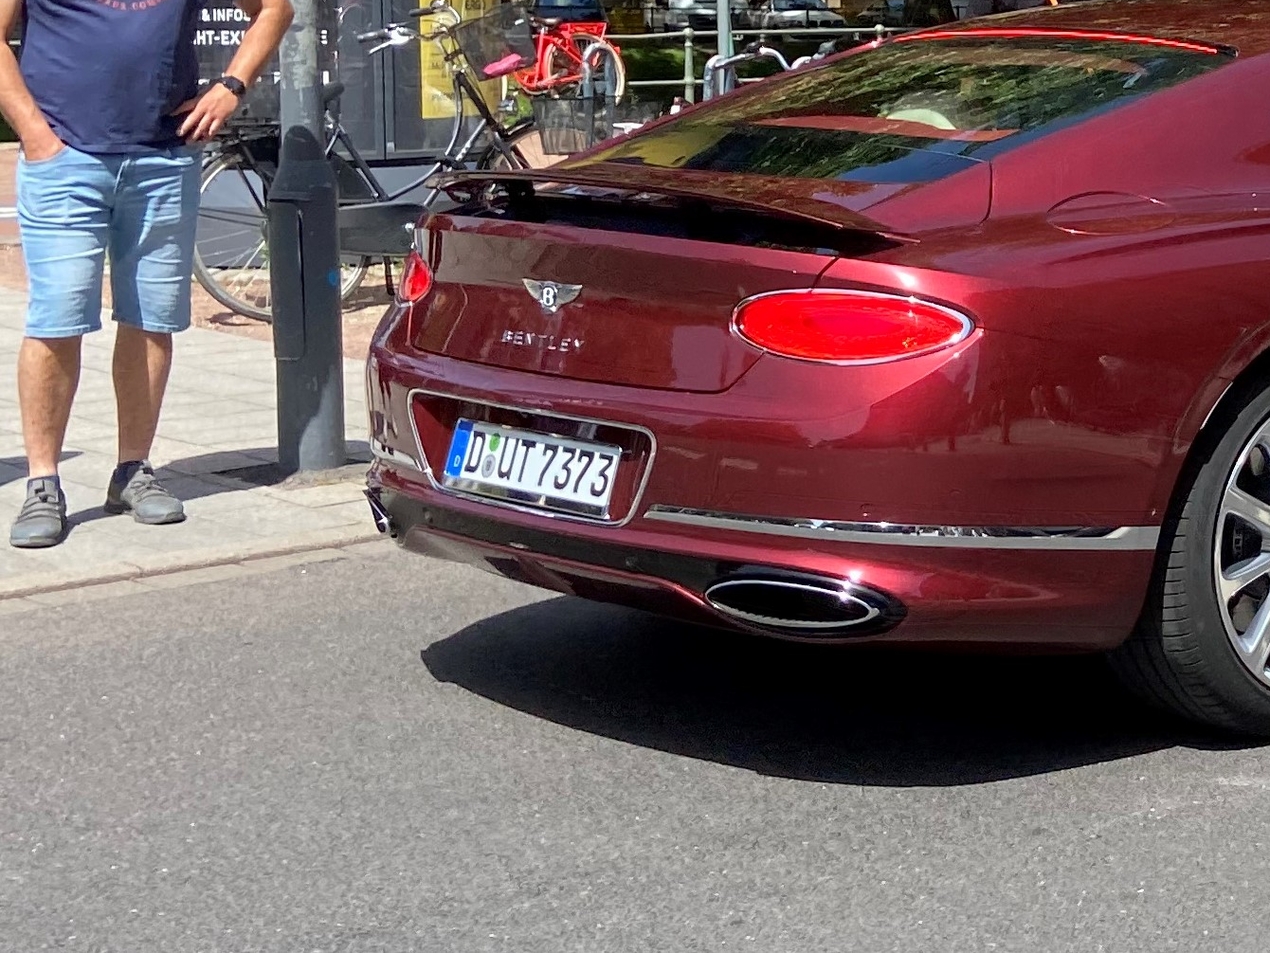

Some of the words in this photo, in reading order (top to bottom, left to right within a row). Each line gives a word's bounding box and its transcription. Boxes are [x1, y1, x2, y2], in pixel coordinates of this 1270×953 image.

[464, 430, 486, 473] D
[497, 436, 537, 483] UT
[537, 444, 614, 497] 7373
